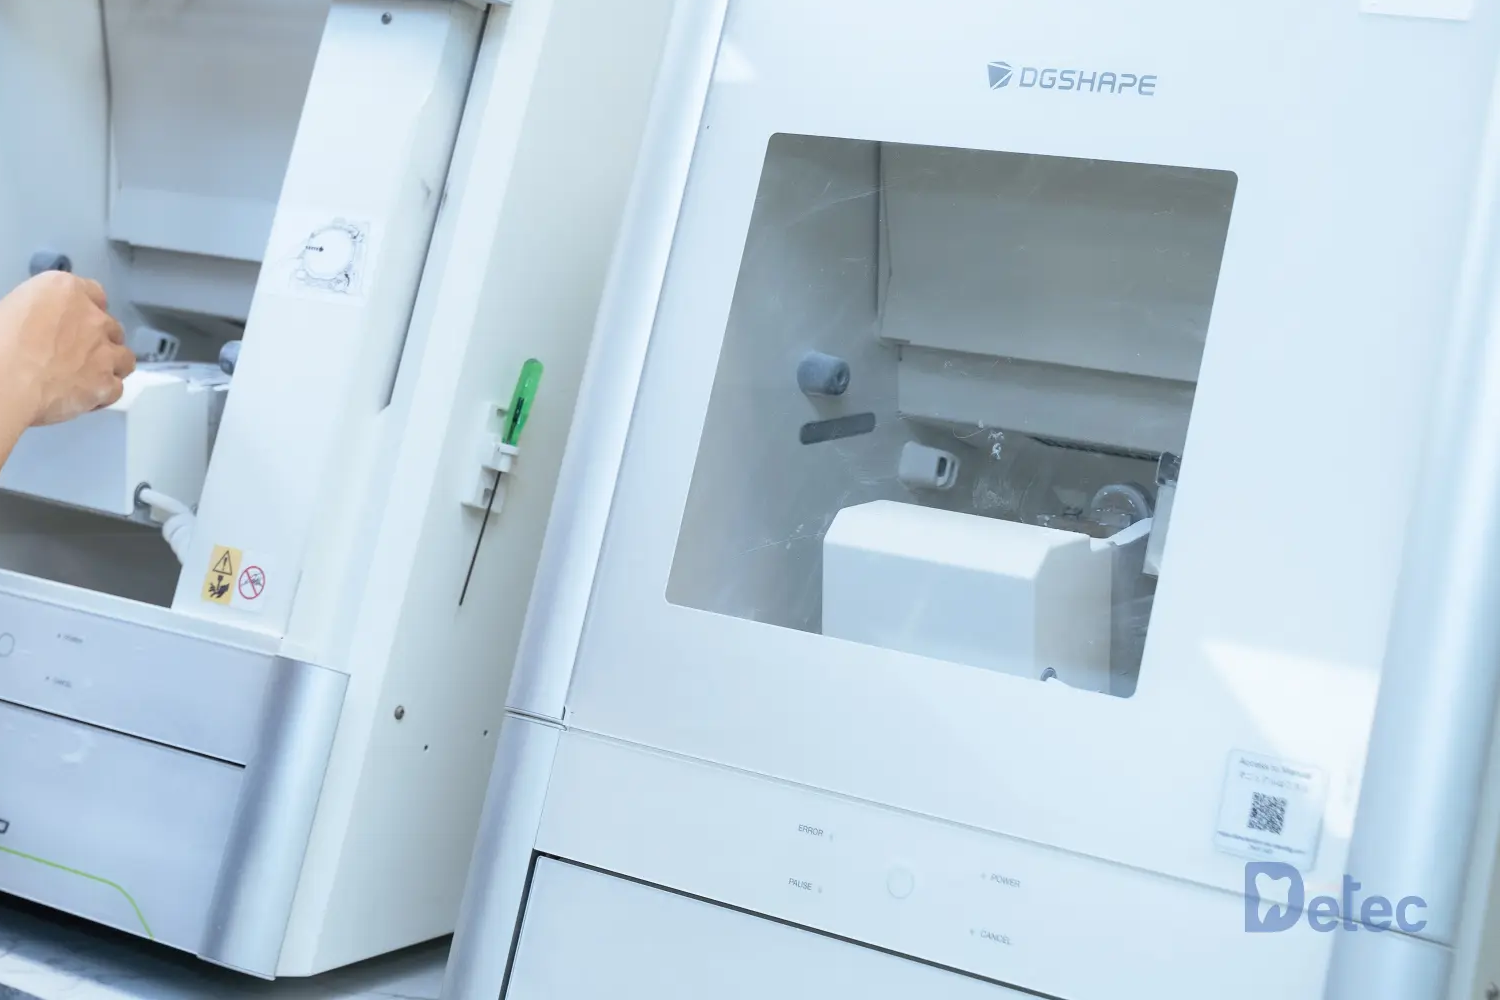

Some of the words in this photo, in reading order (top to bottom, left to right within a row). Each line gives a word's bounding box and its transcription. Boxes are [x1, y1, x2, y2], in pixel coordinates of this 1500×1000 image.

[1019, 66, 1157, 96] DGSHAPE
[798, 823, 824, 837] ERROR
[787, 877, 813, 891] PAUSE
[990, 872, 1021, 889] POWER
